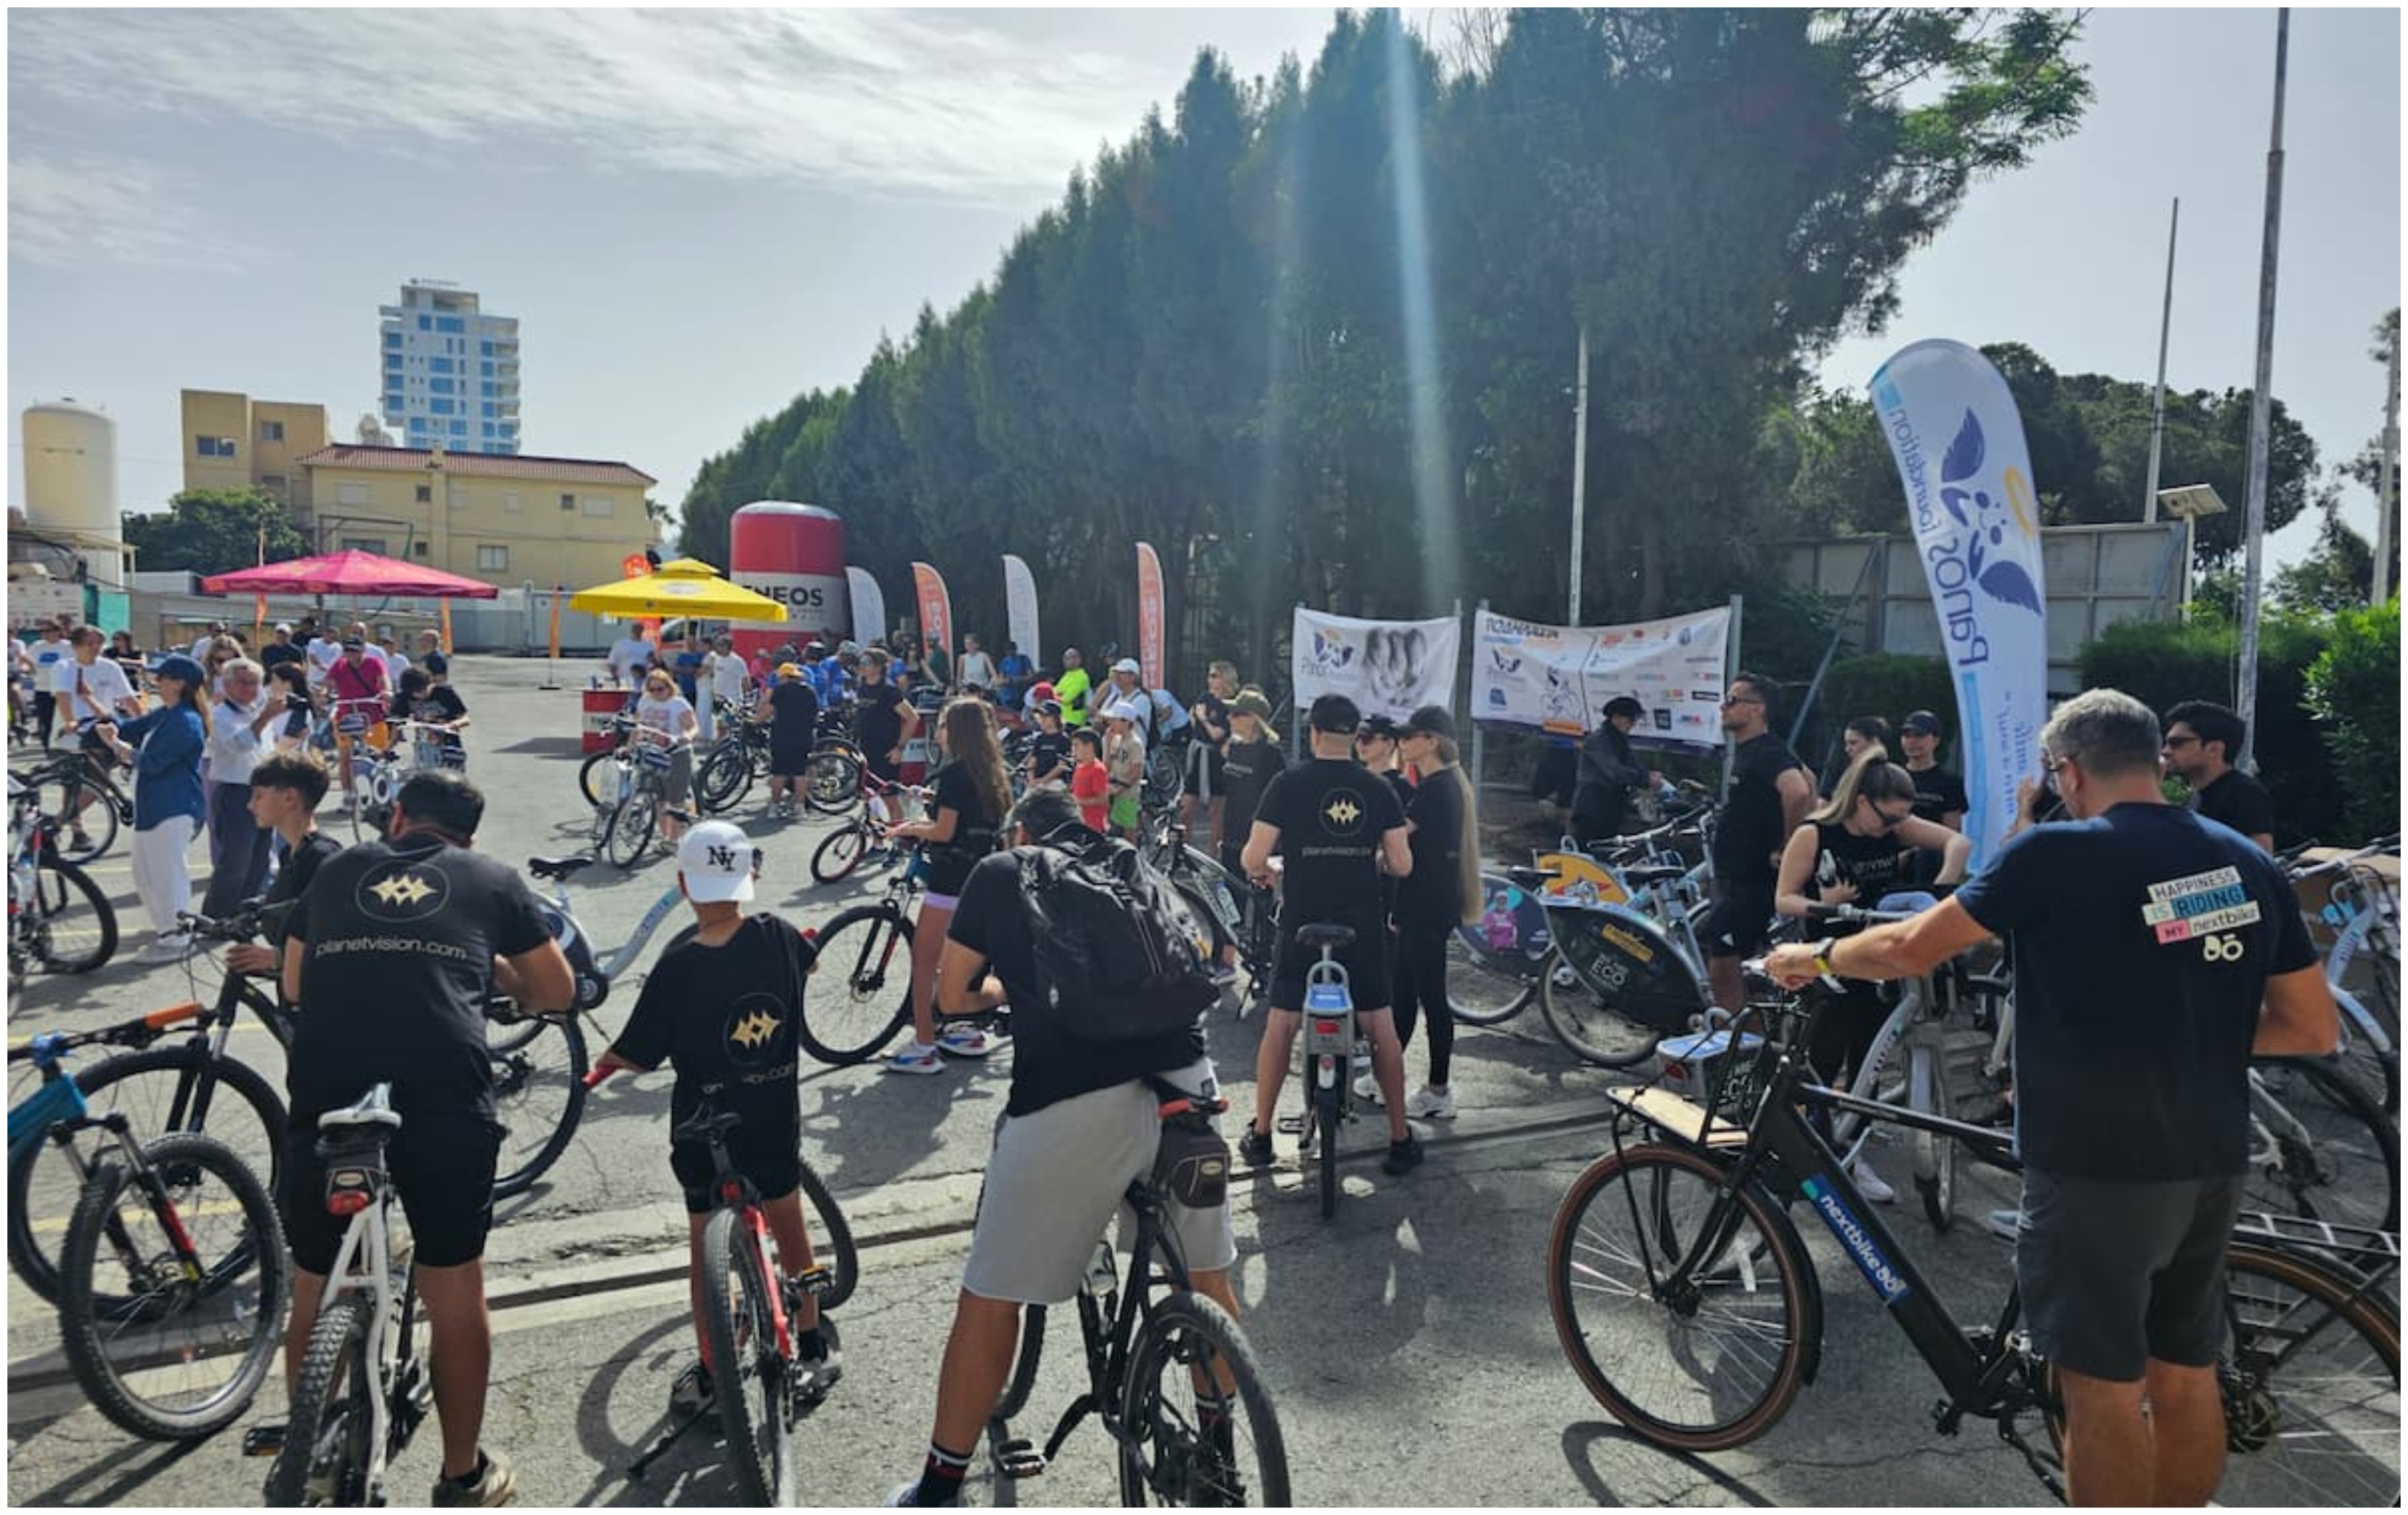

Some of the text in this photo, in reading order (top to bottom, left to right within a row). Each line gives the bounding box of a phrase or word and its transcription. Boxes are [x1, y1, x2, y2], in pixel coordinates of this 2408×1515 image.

[741, 585, 823, 607] NEOS
[707, 844, 736, 872] NY
[2154, 870, 2235, 898] HAPPINESS
[2152, 886, 2242, 919] IS RIDING
[2165, 927, 2184, 938] MY
[316, 935, 468, 959] planetvision.com
[1819, 1194, 1881, 1270] nextbike
